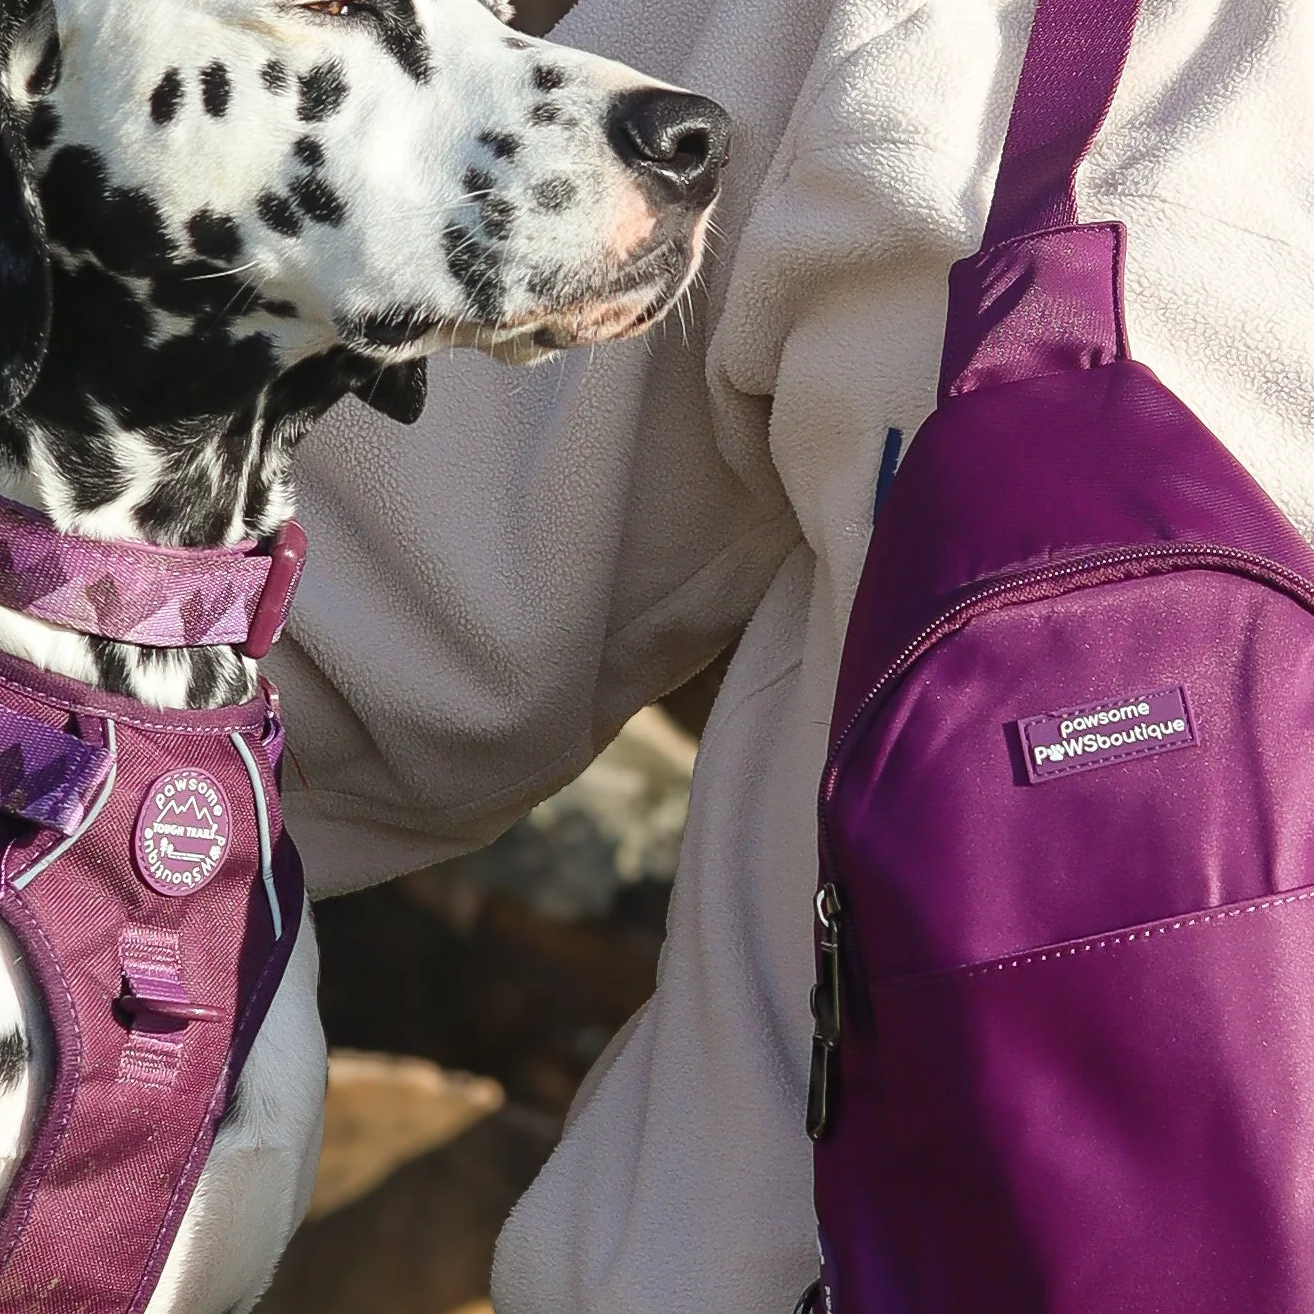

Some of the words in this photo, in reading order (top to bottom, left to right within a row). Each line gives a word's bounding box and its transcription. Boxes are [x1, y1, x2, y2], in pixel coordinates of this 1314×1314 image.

[1060, 701, 1151, 739] pawsome
[155, 778, 223, 818] pawsome
[152, 821, 185, 836] TOUGH
